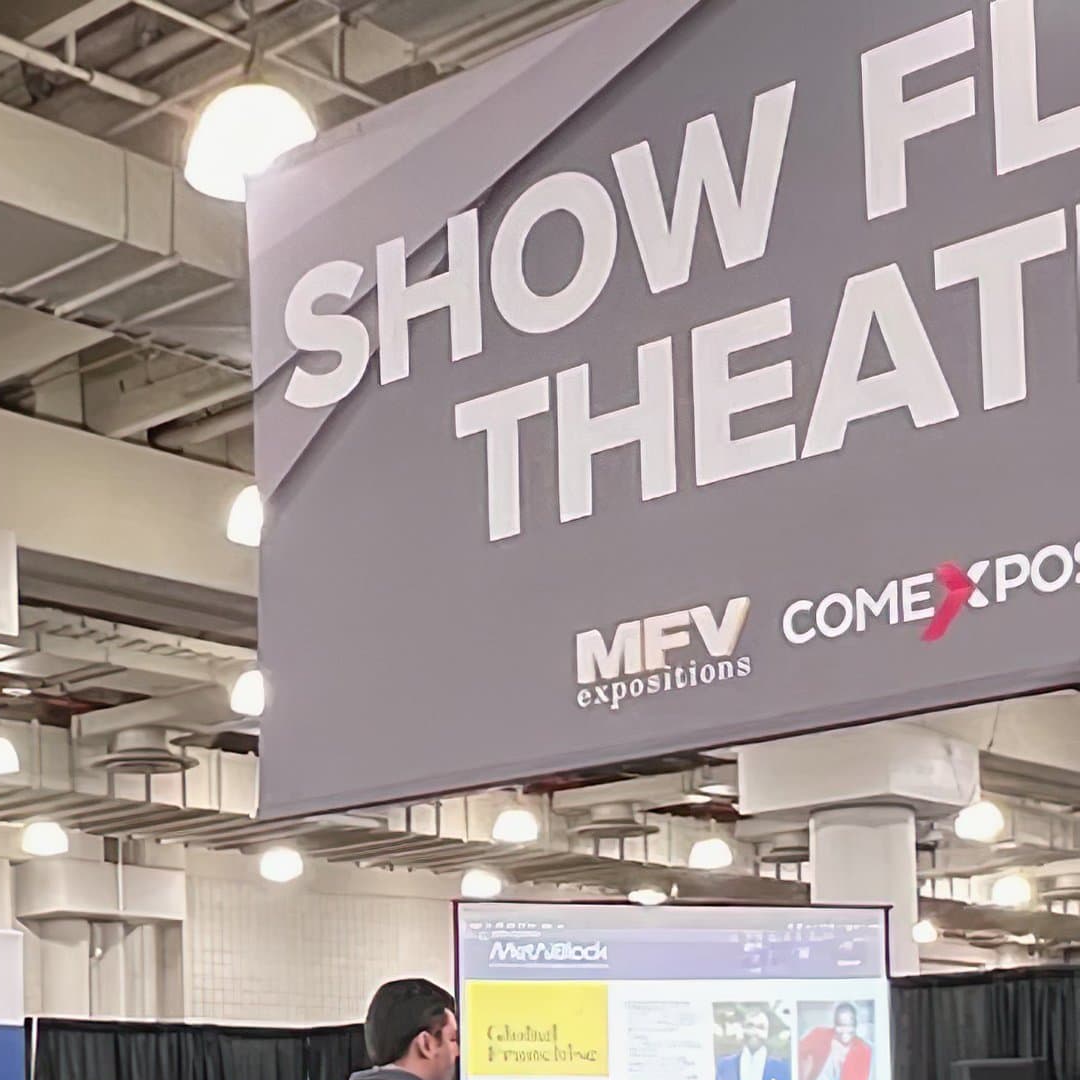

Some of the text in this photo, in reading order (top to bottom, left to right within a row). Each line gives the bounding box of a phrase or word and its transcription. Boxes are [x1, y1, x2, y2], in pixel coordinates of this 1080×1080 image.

[284, 80, 796, 408] SHOW
[454, 205, 1080, 541] THEAT
[576, 596, 751, 684] MFV
[782, 541, 1080, 644] COMEXPO
[576, 656, 752, 710] expositions
